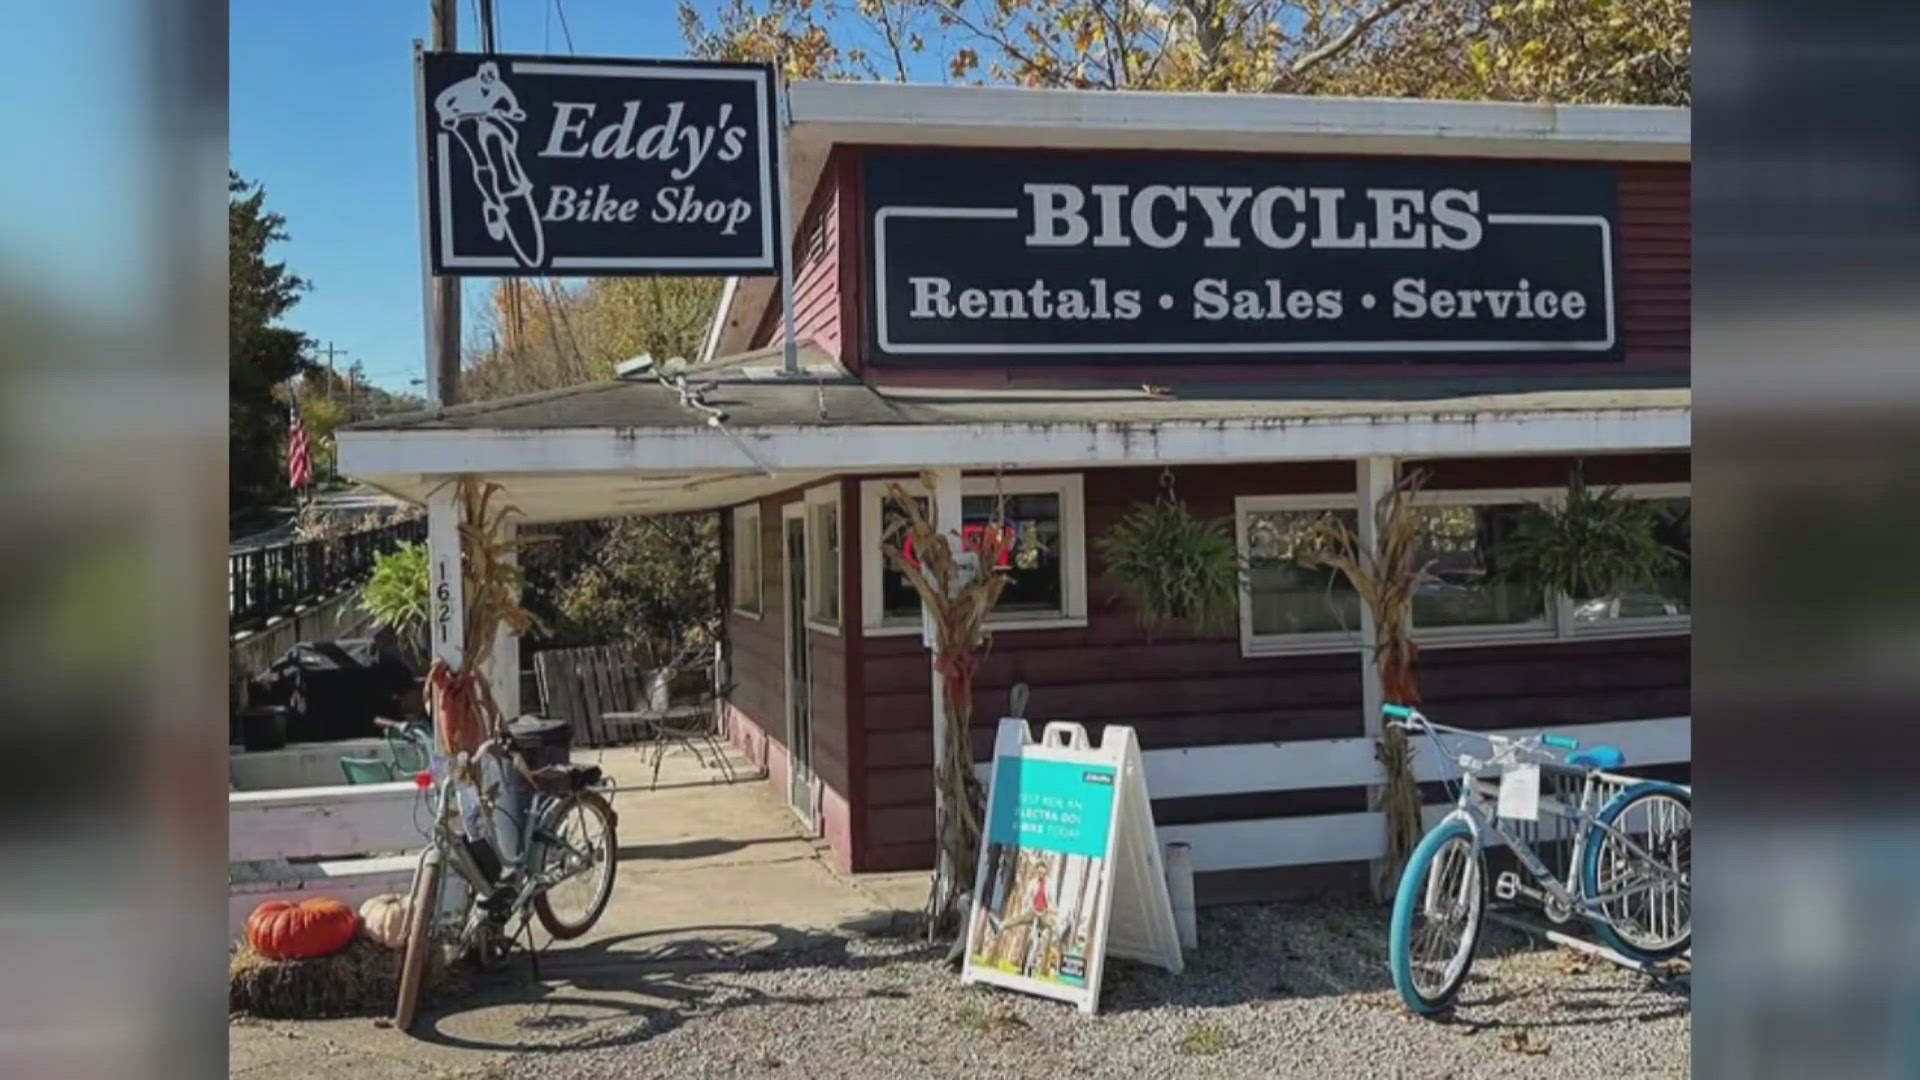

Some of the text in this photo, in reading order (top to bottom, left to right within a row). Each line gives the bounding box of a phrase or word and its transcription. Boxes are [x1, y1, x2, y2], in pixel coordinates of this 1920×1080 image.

[538, 101, 747, 181] Eddy's
[542, 185, 752, 235] Bike Shop
[1023, 183, 1483, 251] BICYCLES
[908, 276, 1588, 320] Rentals Sales Service
[436, 561, 451, 643] 1621
